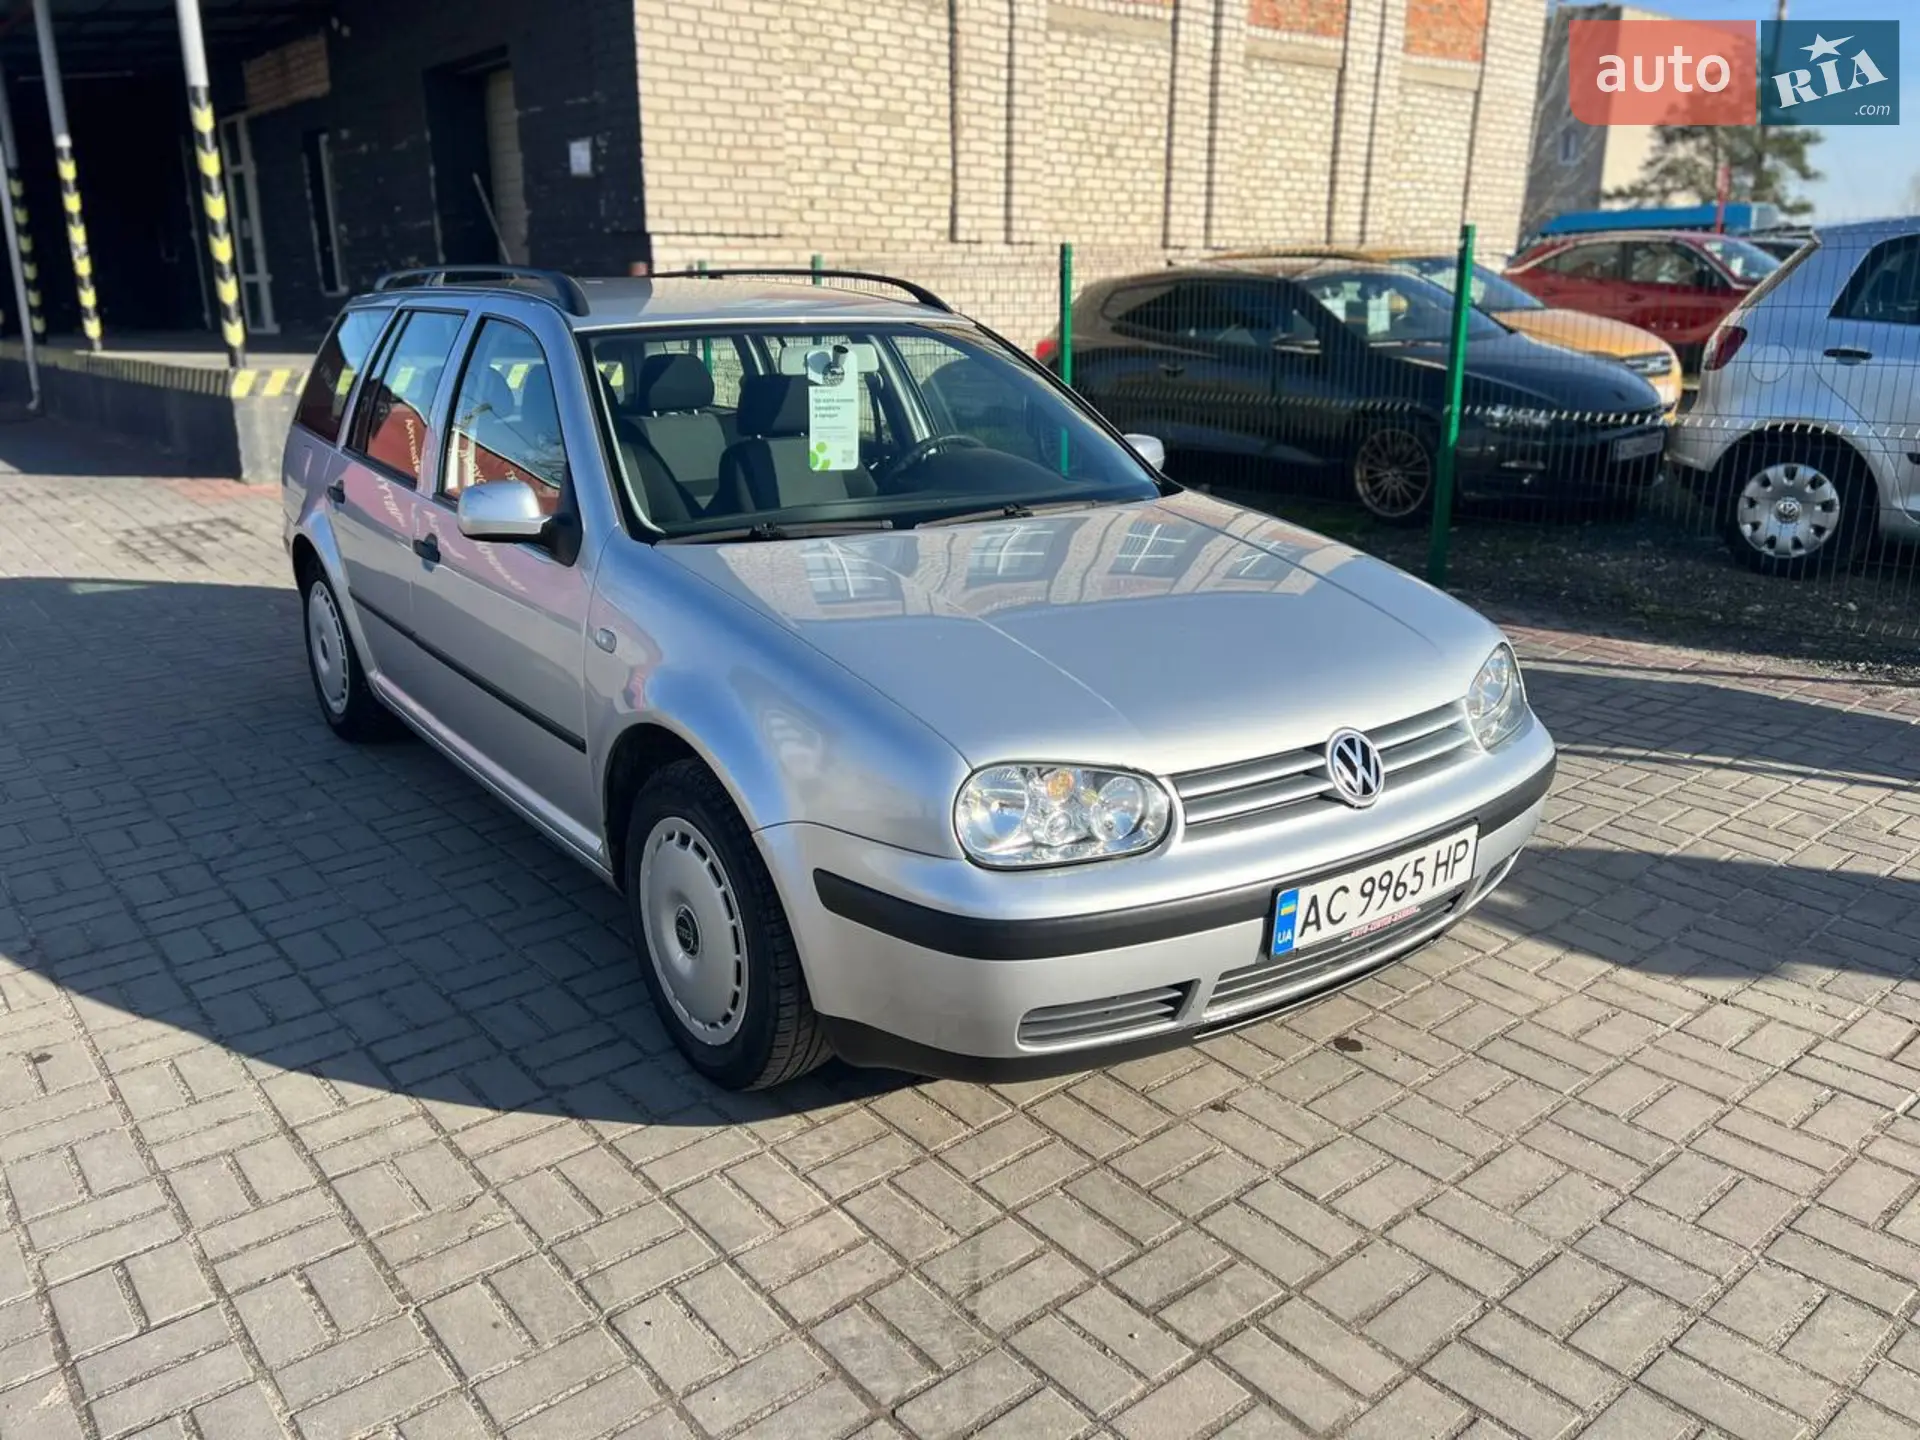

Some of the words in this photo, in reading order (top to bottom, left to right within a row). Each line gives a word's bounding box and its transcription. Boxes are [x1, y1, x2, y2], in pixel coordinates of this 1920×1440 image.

[1298, 885, 1350, 938] AC
[1358, 857, 1426, 918] 9965
[1432, 839, 1469, 887] HP
[1277, 929, 1293, 944] UA
